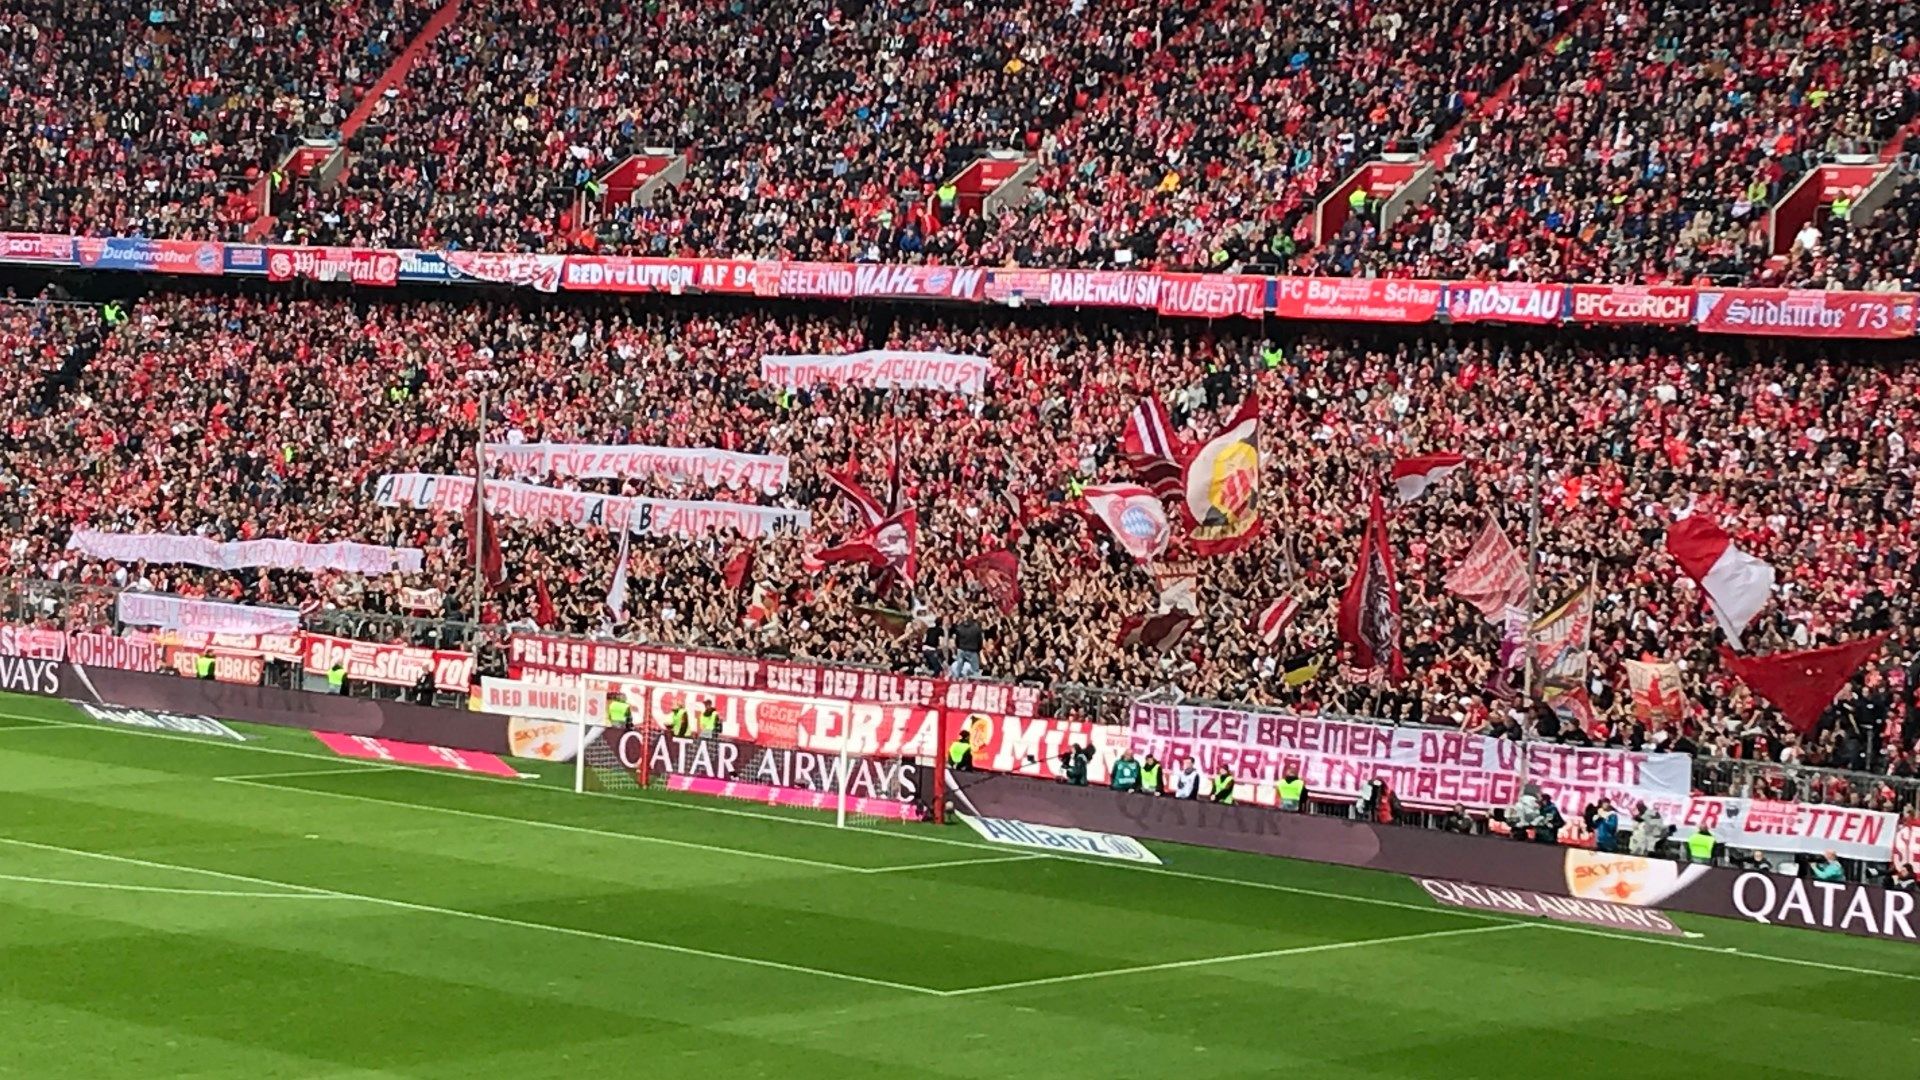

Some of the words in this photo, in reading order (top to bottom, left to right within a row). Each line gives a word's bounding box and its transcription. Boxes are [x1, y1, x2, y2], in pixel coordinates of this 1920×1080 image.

[401, 258, 446, 274] Allianz
[702, 264, 729, 286] AF
[734, 265, 757, 288] 94
[780, 268, 854, 295] SEELAND
[1281, 281, 1304, 300] FC
[1575, 292, 1615, 317] BFC
[512, 638, 589, 669] POLIZEI
[436, 657, 473, 688] rot
[490, 688, 522, 709] RED
[757, 747, 917, 801] AIRWAYS
[977, 815, 1107, 856] Allianz
[1420, 878, 1537, 912] QATAR
[1534, 892, 1674, 931] AIRWAYS
[1732, 871, 1917, 938] QATAR
